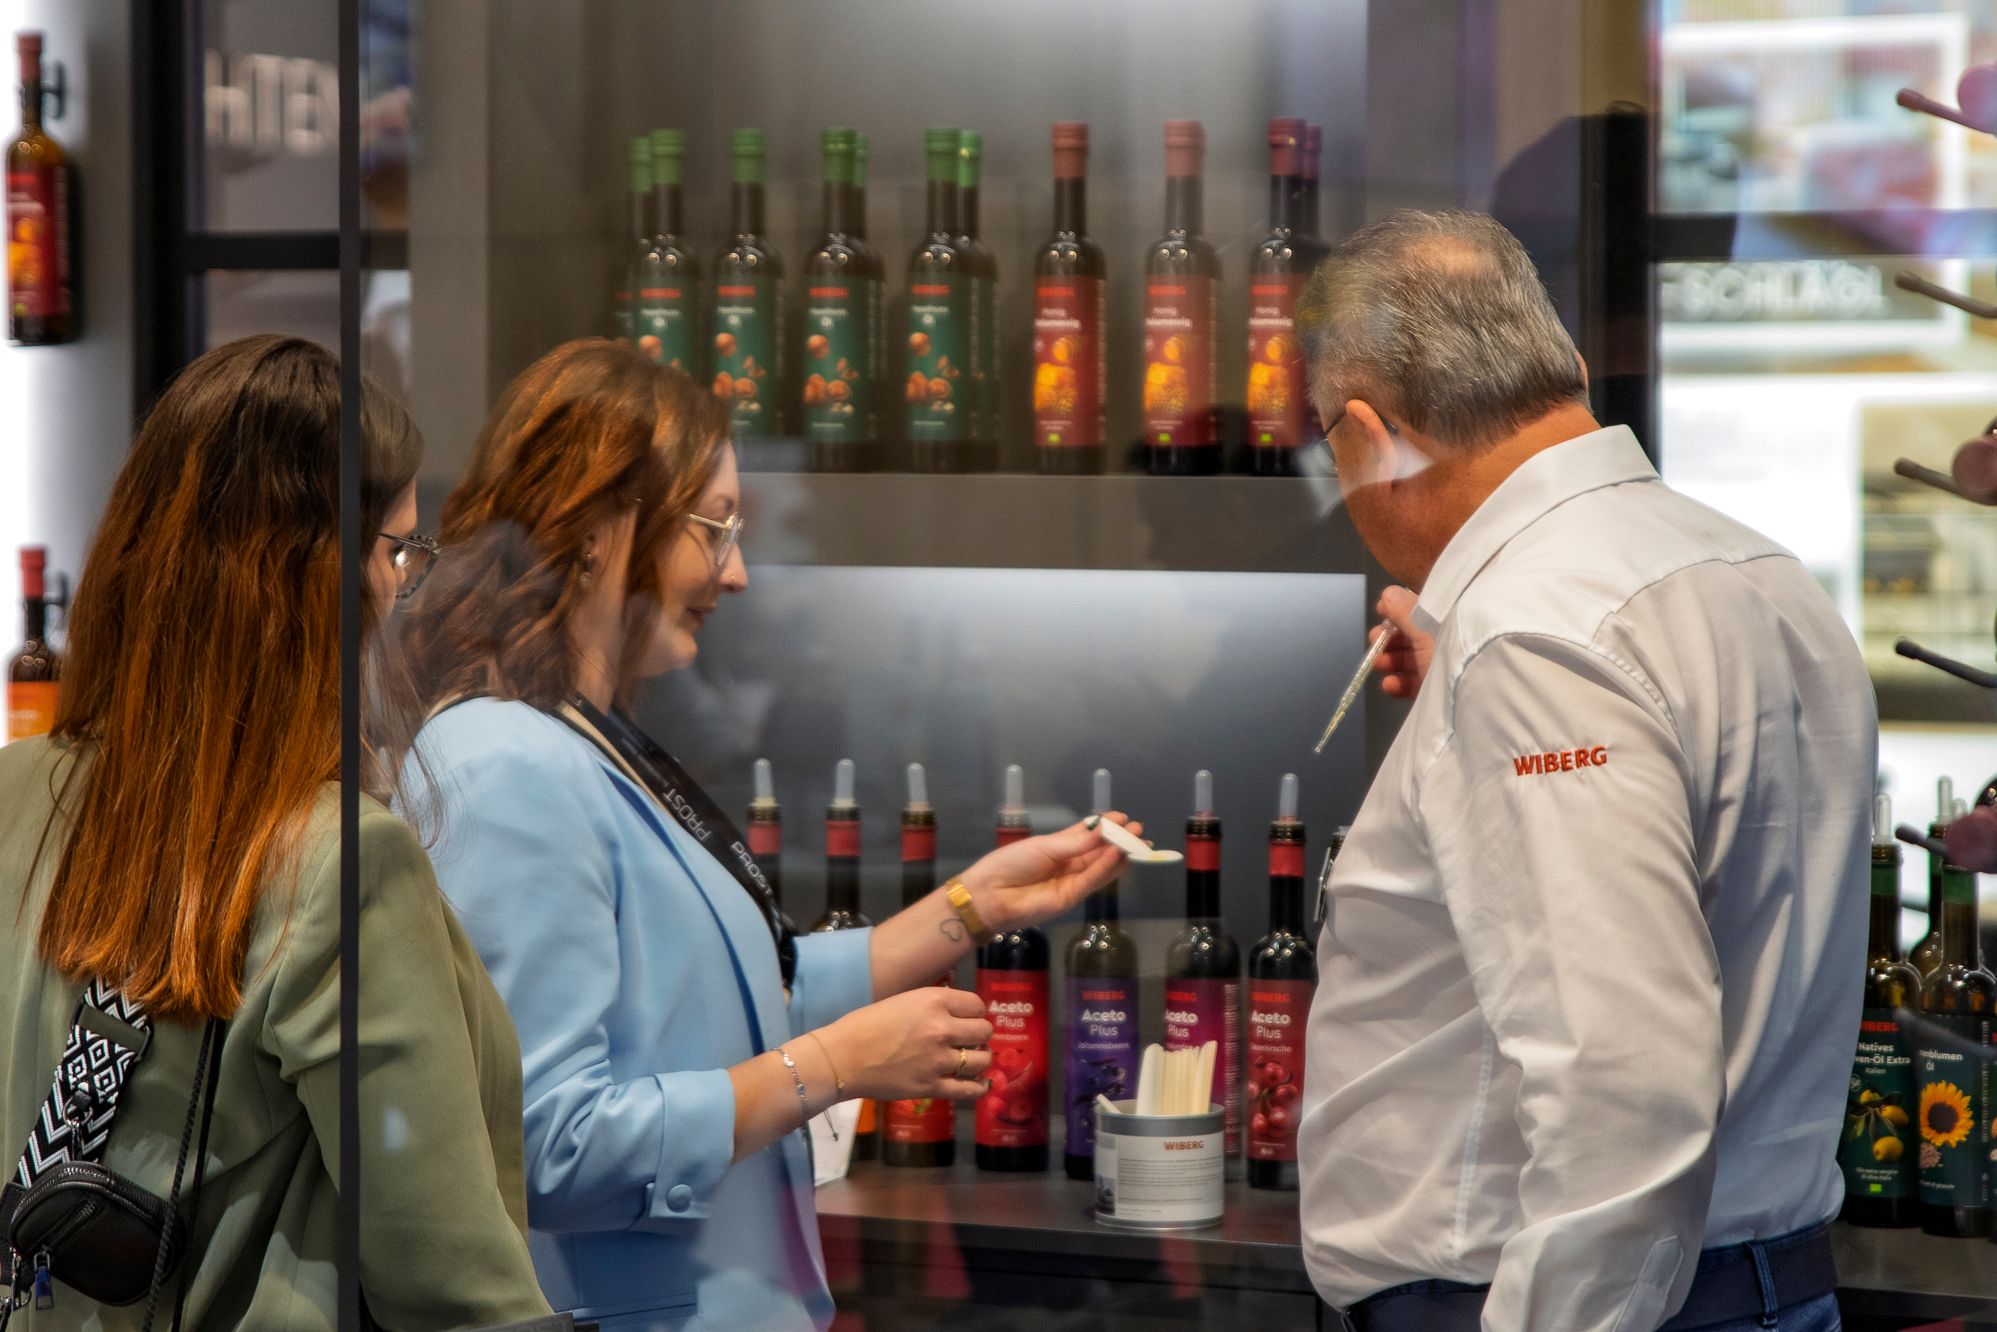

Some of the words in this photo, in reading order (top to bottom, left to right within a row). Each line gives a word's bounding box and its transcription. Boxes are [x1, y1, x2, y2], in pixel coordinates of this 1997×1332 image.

[1513, 745, 1608, 776] WIBERG
[663, 788, 712, 841] PROST
[989, 1000, 1034, 1013] Aceto
[996, 1016, 1025, 1028] Plus
[1081, 1009, 1127, 1022] Aceto
[1251, 1009, 1292, 1024] Aceto
[1090, 1025, 1119, 1037] Plus
[1167, 1025, 1190, 1038] Plus
[1256, 1026, 1282, 1039] Plus
[1858, 1042, 1894, 1052] Natives
[1887, 1055, 1911, 1065] Extra
[1164, 1140, 1205, 1151] WIBERG
